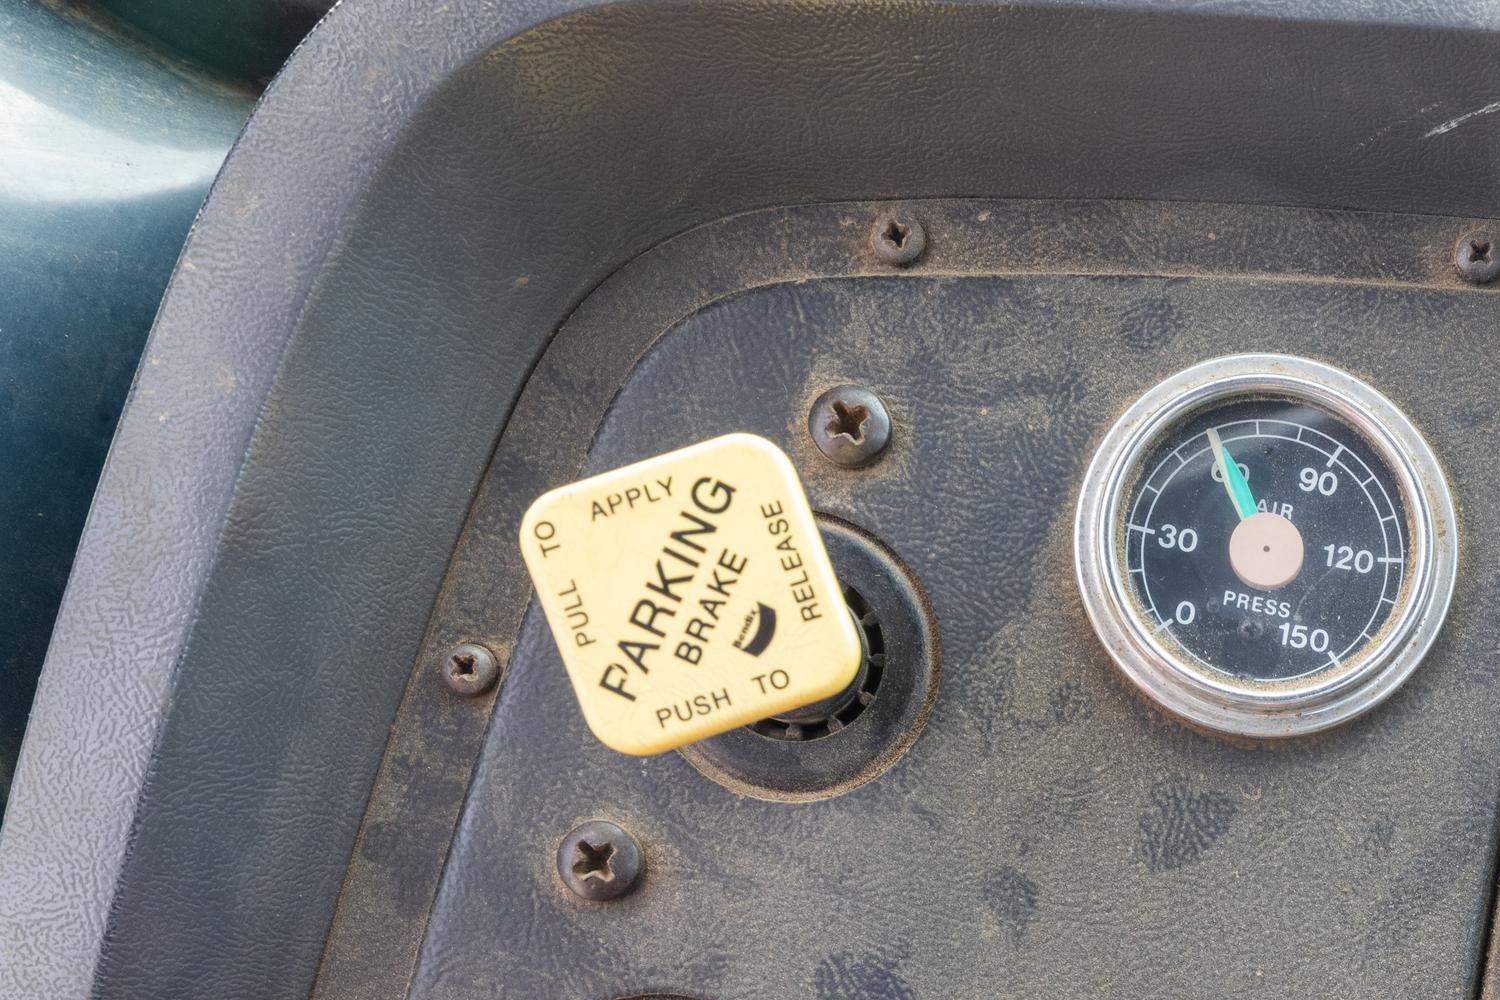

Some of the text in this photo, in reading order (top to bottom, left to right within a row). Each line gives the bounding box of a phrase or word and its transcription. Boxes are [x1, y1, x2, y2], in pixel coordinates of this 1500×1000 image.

[1299, 467, 1338, 496] 90
[1257, 498, 1294, 520] AIR
[1158, 524, 1198, 552] 30
[534, 476, 674, 647] PULL TO APPLY
[1323, 543, 1374, 574] 120
[599, 477, 737, 702] PARKING
[1223, 590, 1291, 618] PRESS
[656, 499, 822, 729] PUSH TO RELEASE
[674, 549, 748, 666] BRAKE
[1175, 600, 1196, 625] 0
[1278, 622, 1329, 652] 150
